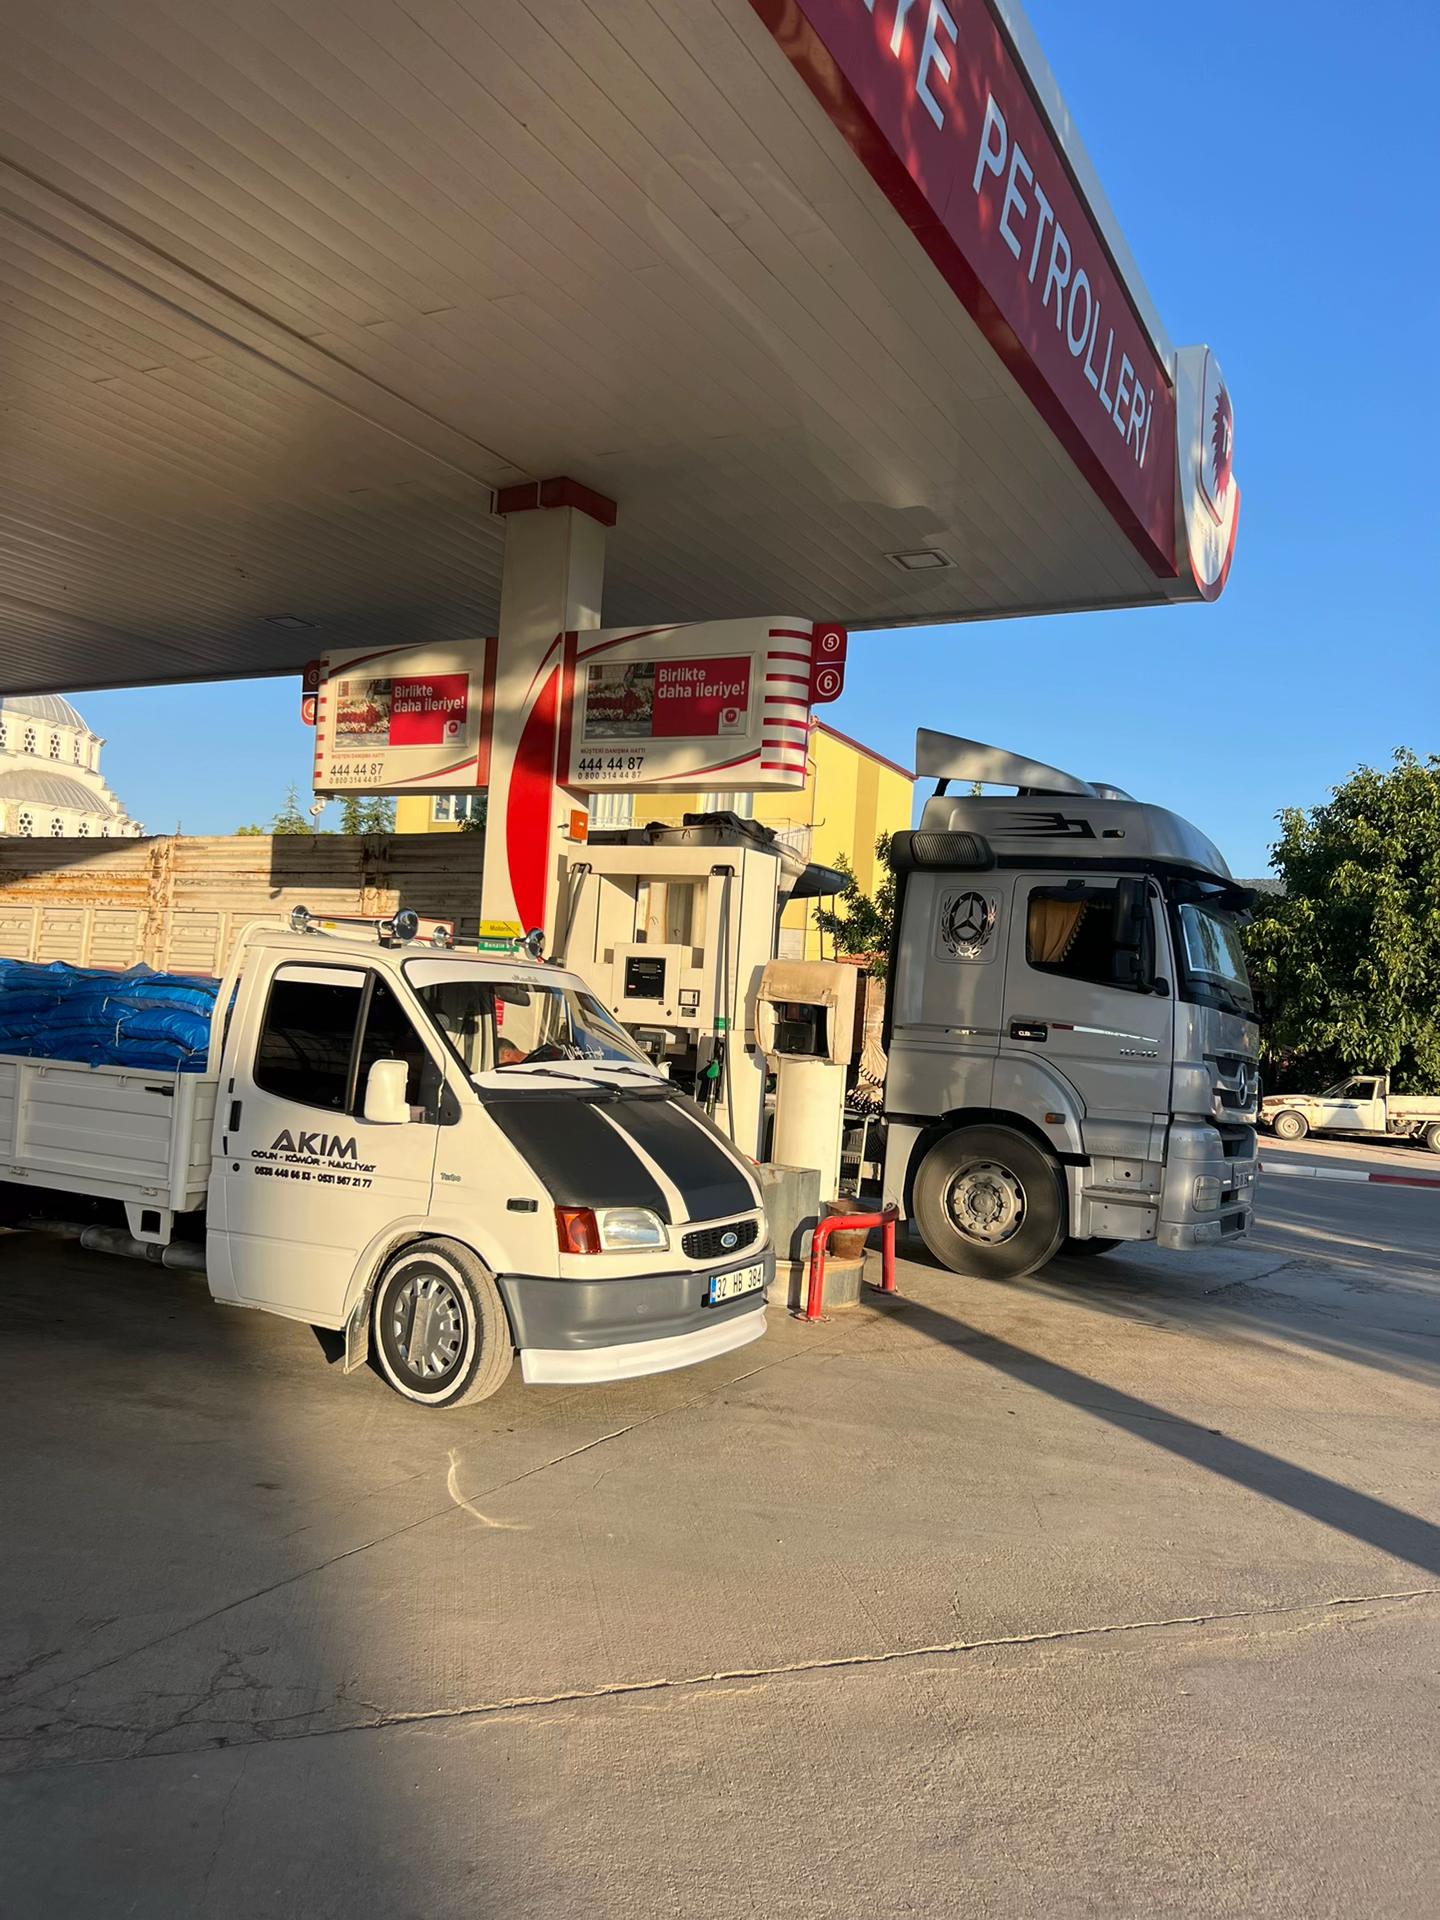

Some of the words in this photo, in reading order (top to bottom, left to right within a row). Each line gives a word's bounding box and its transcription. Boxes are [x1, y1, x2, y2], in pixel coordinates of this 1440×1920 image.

[972, 92, 1154, 469] PETROLLERİ
[827, 637, 834, 648] 5
[659, 668, 706, 682] Birlikte
[823, 675, 833, 690] 6
[394, 685, 433, 698] Birlikte
[658, 685, 692, 699] daha
[695, 681, 745, 698] ileriye!
[393, 700, 422, 712] daha
[424, 696, 465, 712] ileriye!
[330, 764, 350, 776] 444
[353, 763, 366, 775] 44
[370, 763, 384, 775] 87
[578, 757, 602, 771] 444
[607, 757, 623, 770] 44
[627, 756, 644, 770] 87
[577, 772, 583, 780] 0
[602, 771, 616, 779] 314
[619, 771, 629, 779] 44
[631, 771, 642, 779] 87
[270, 1129, 358, 1160] AKIM
[251, 1150, 278, 1160] ODUN
[285, 1155, 320, 1166] KÖMÜR
[327, 1160, 377, 1172] NAKLİYAT
[352, 1177, 361, 1187] 21
[362, 1178, 373, 1188] 77
[717, 1277, 727, 1298] 32
[733, 1272, 743, 1294] HB
[747, 1267, 762, 1288] 384
